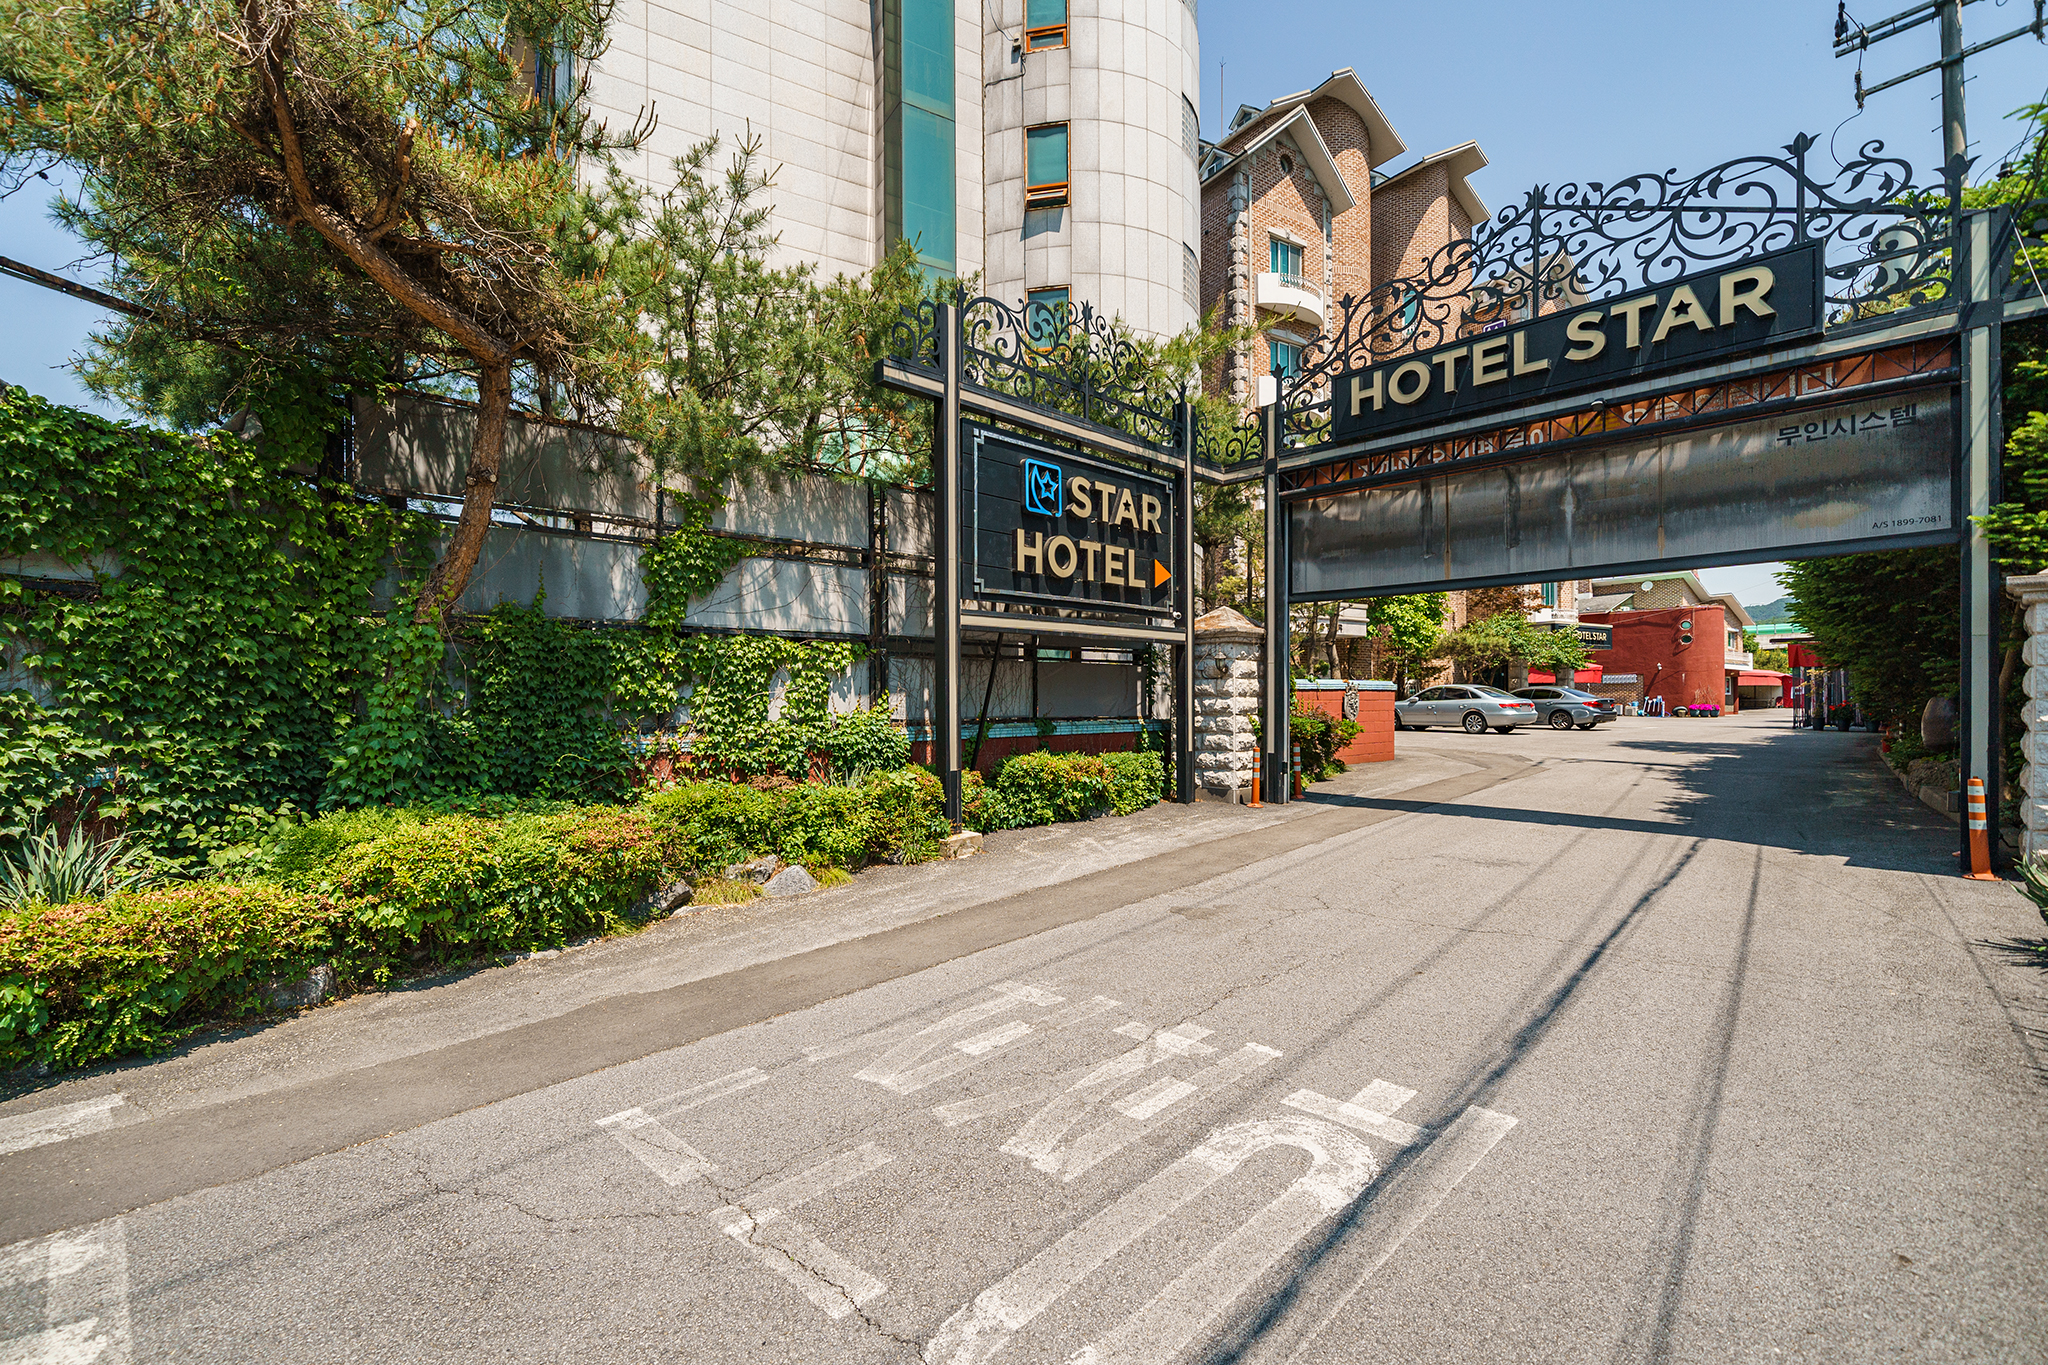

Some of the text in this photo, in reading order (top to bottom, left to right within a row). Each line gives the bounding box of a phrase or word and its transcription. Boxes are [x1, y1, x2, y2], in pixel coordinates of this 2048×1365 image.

[1350, 266, 1778, 417] HOTEL STAR
[1695, 366, 1838, 413] 열립니다
[1776, 403, 1917, 446] 무인시스템
[1066, 475, 1163, 534] STAR
[1872, 514, 1943, 530] A/S 1899-7081
[1012, 527, 1147, 589] HOTEL
[1592, 631, 1607, 641] STAR
